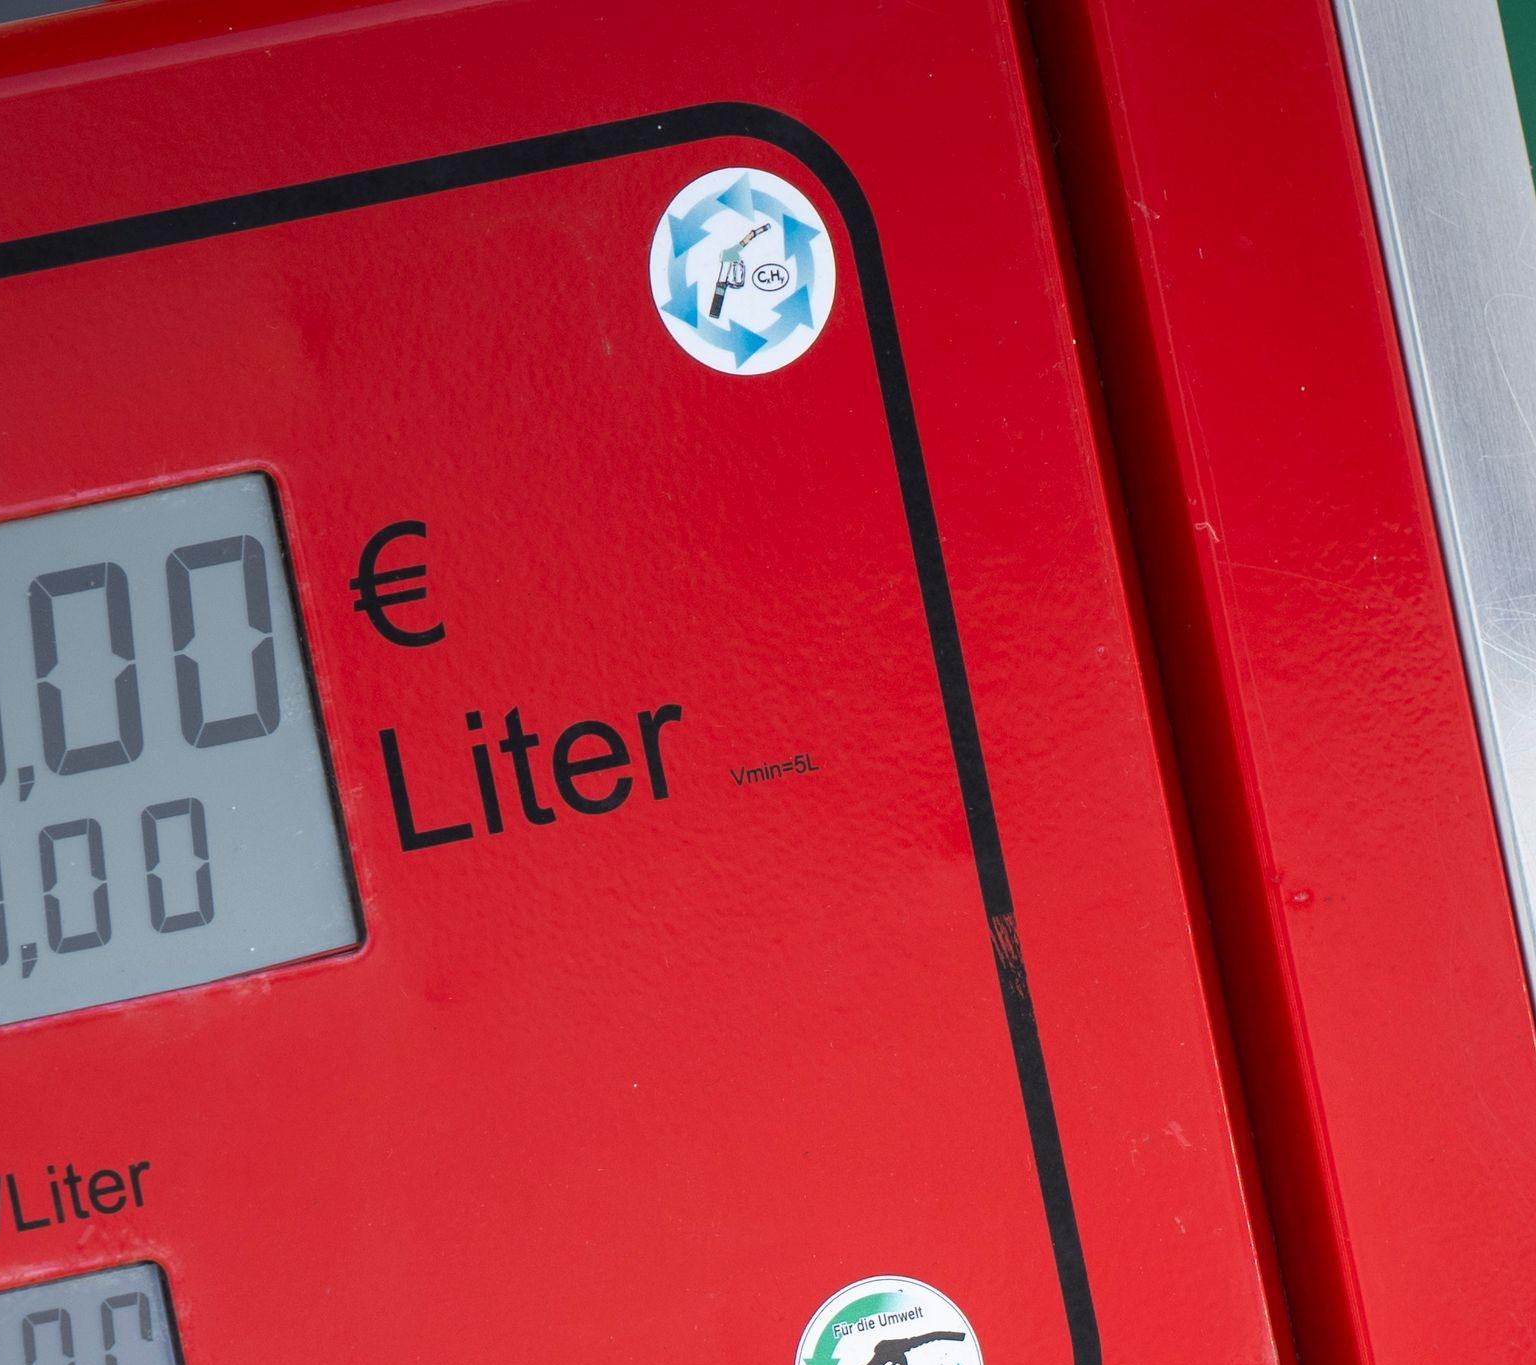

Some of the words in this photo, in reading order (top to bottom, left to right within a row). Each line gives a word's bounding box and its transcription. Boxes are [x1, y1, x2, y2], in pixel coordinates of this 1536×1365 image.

[349, 520, 446, 647] €
[379, 704, 683, 852] Liter
[730, 753, 821, 787] Vmin=5L
[833, 1322, 853, 1338] Für
[857, 1318, 876, 1334] die
[878, 1306, 924, 1328] Umwelt
